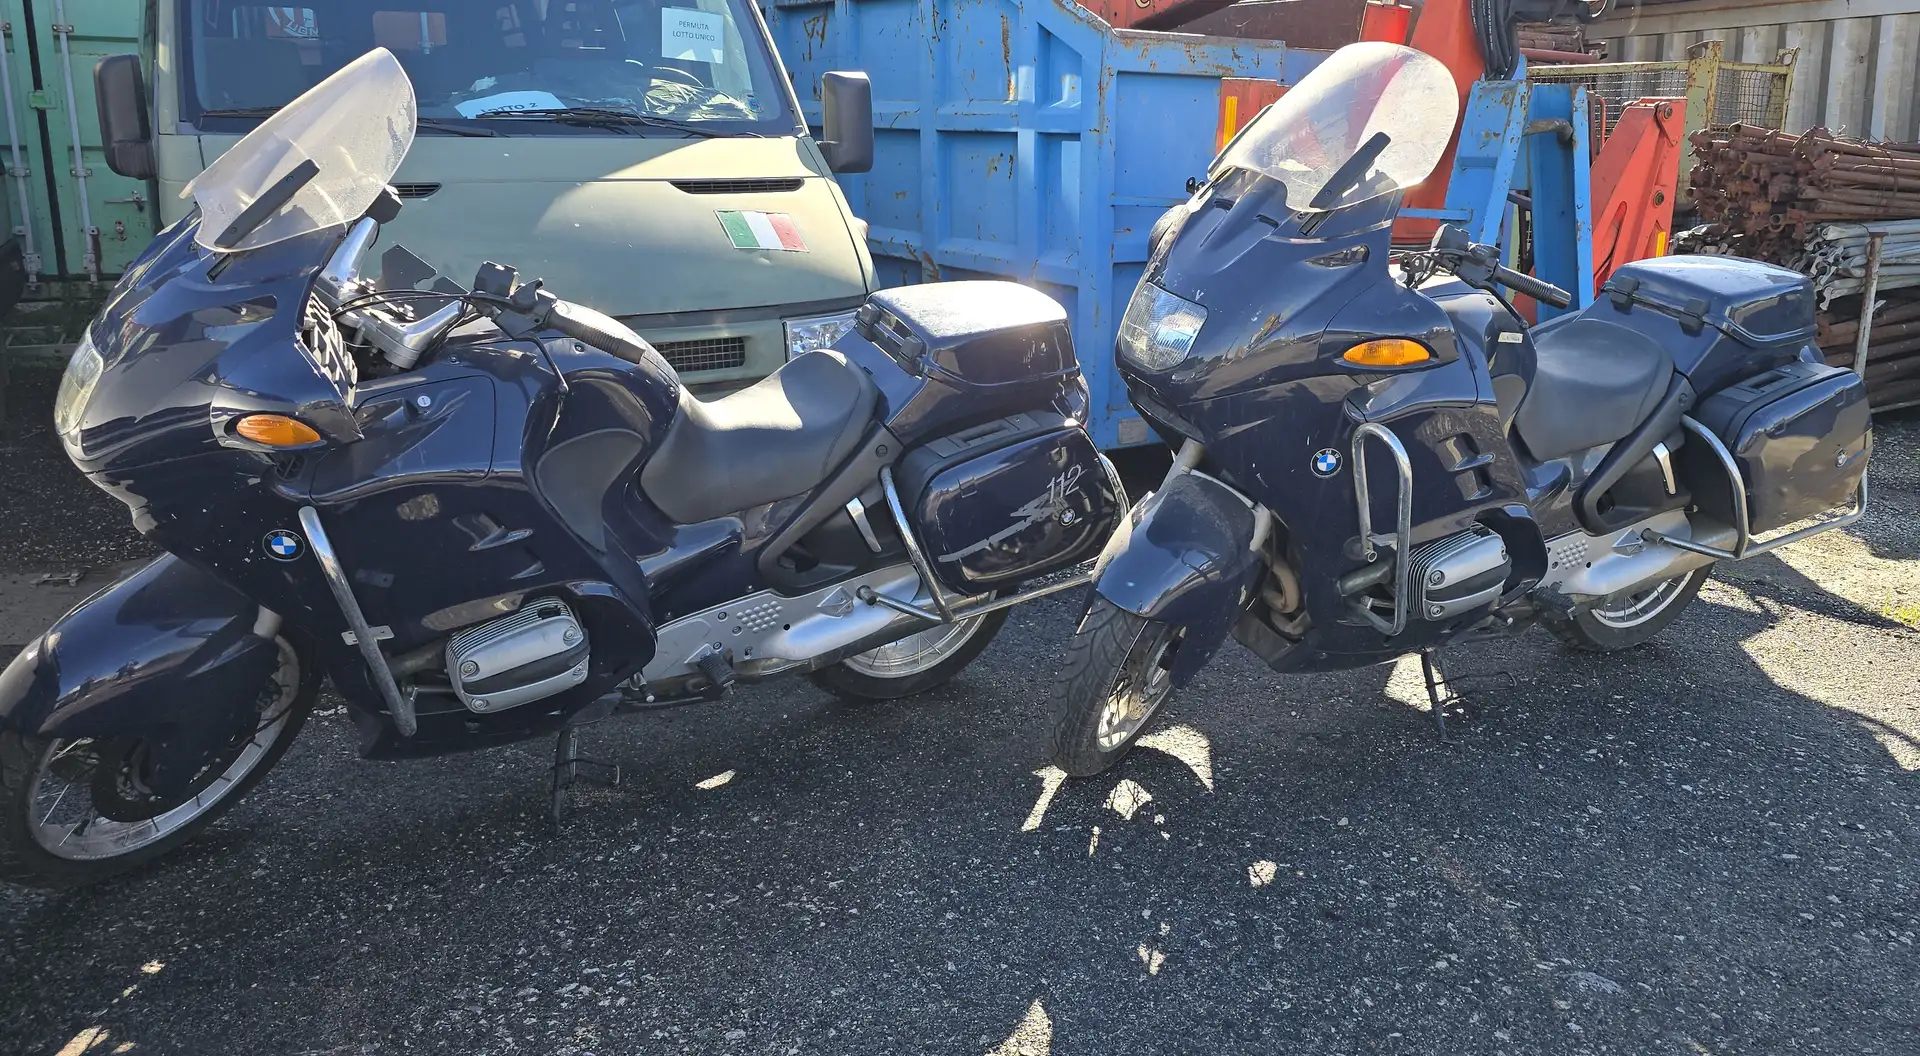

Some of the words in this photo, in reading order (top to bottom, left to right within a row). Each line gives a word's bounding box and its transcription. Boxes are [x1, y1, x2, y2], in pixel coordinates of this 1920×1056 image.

[678, 20, 710, 31] PERMUTA
[672, 30, 694, 39] LOTTO
[695, 33, 715, 42] UNICO
[1046, 464, 1082, 504] 112
